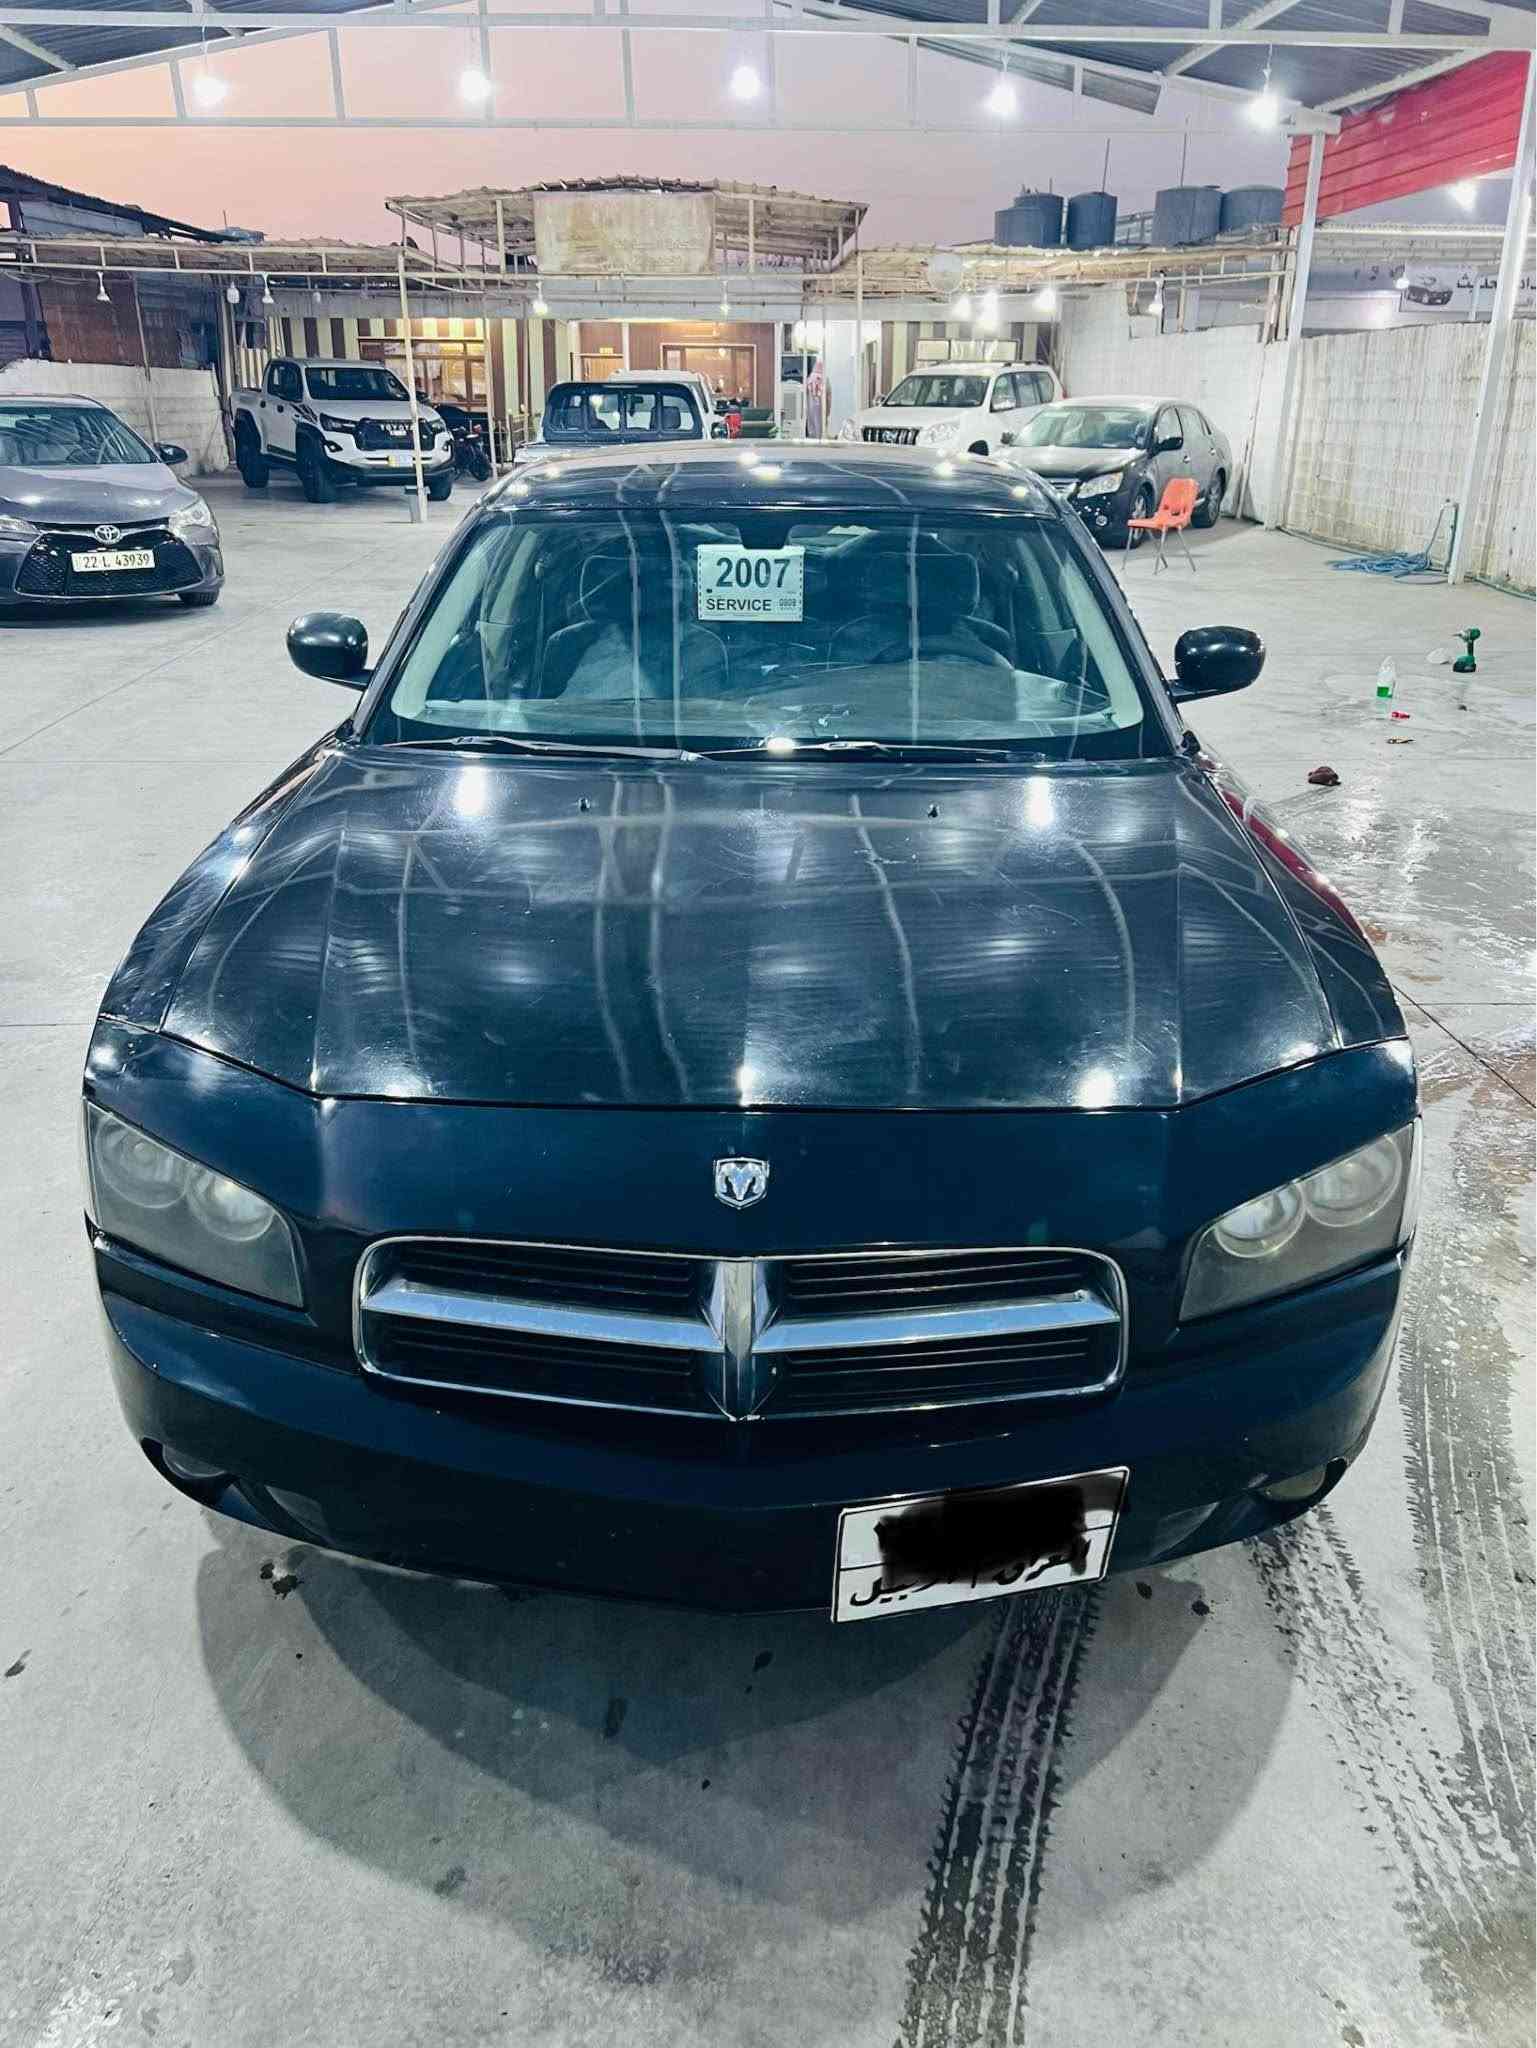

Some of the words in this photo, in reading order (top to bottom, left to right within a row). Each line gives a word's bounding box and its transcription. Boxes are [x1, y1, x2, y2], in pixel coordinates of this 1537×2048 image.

[82, 556, 97, 569] 22
[115, 553, 150, 567] 43939
[716, 557, 791, 588] 2007
[706, 598, 772, 611] SERVICE
